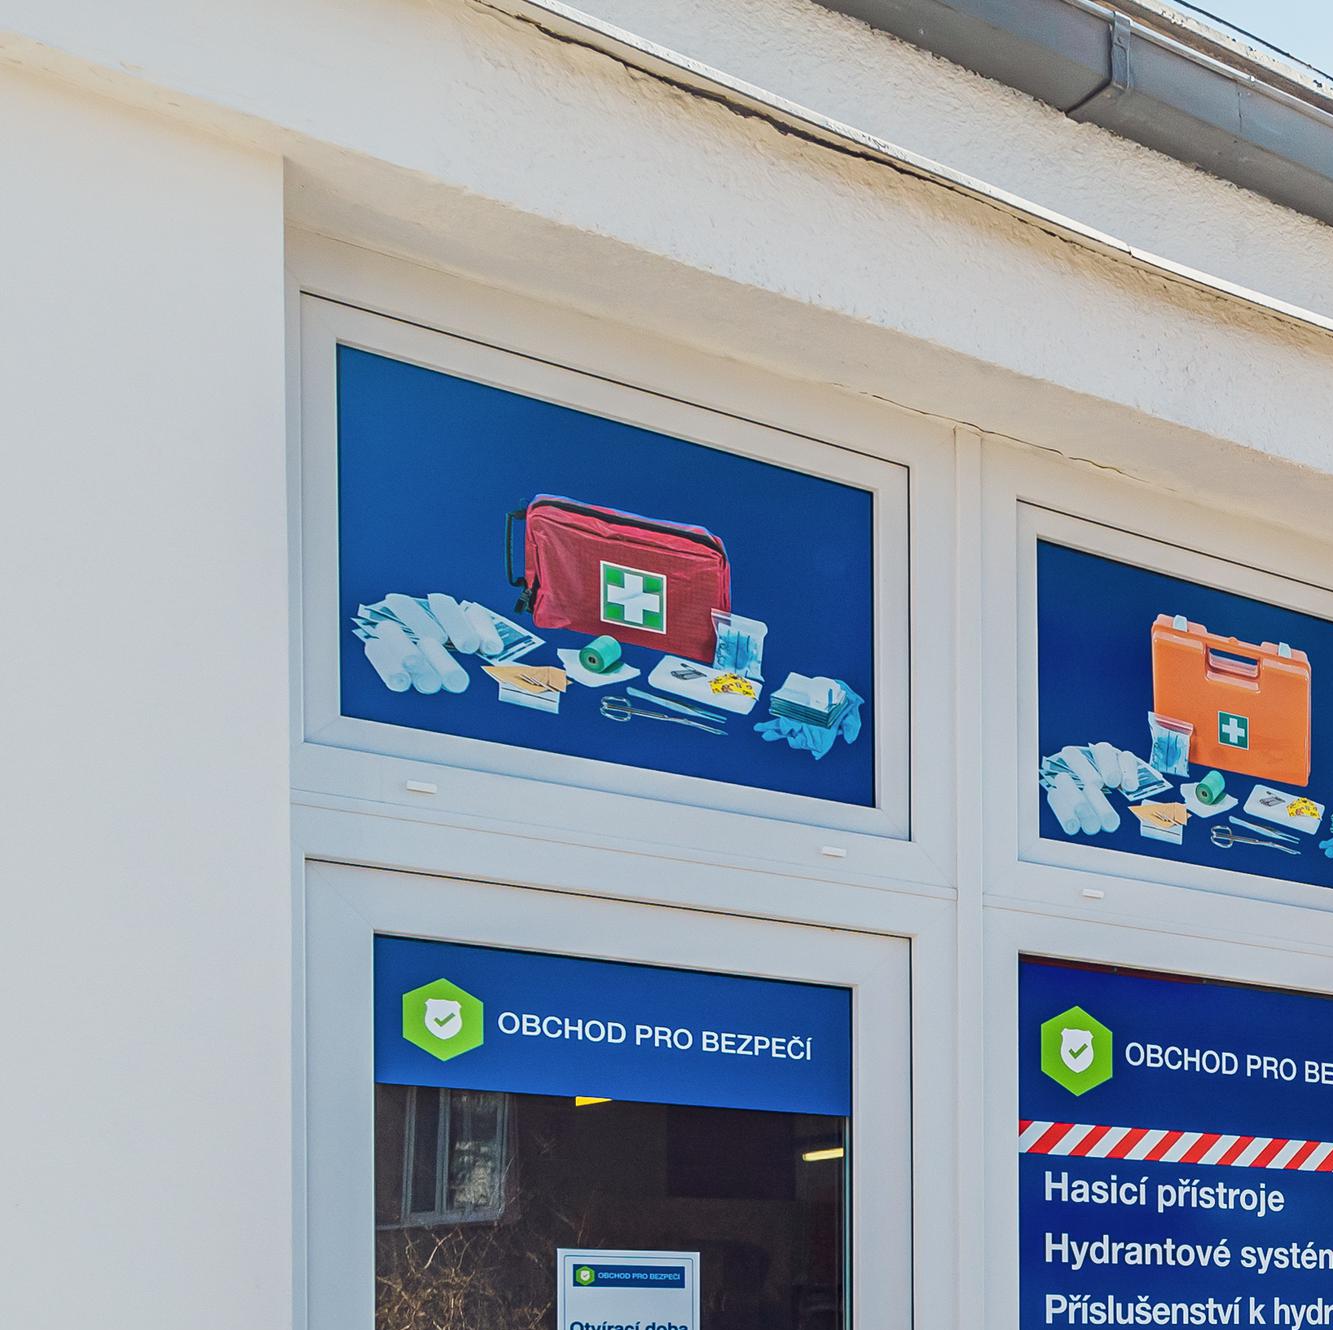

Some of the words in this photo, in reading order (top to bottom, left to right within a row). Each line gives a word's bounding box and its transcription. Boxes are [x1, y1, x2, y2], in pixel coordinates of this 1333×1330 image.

[497, 1010, 626, 1044] OBCHOD
[636, 1024, 693, 1050] PRO
[701, 1031, 812, 1061] BEZPEČÍ
[1125, 1042, 1239, 1076] OBCHOD
[1246, 1055, 1297, 1081] PRO
[1044, 1171, 1148, 1206] Hasicí
[1158, 1178, 1285, 1217] přístroje
[1044, 1232, 1230, 1271] Hydrantové
[597, 1271, 631, 1280] OBCHOD
[632, 1272, 648, 1280] PRO
[1045, 1294, 1240, 1326] Příslušenství
[1249, 1297, 1265, 1325] k
